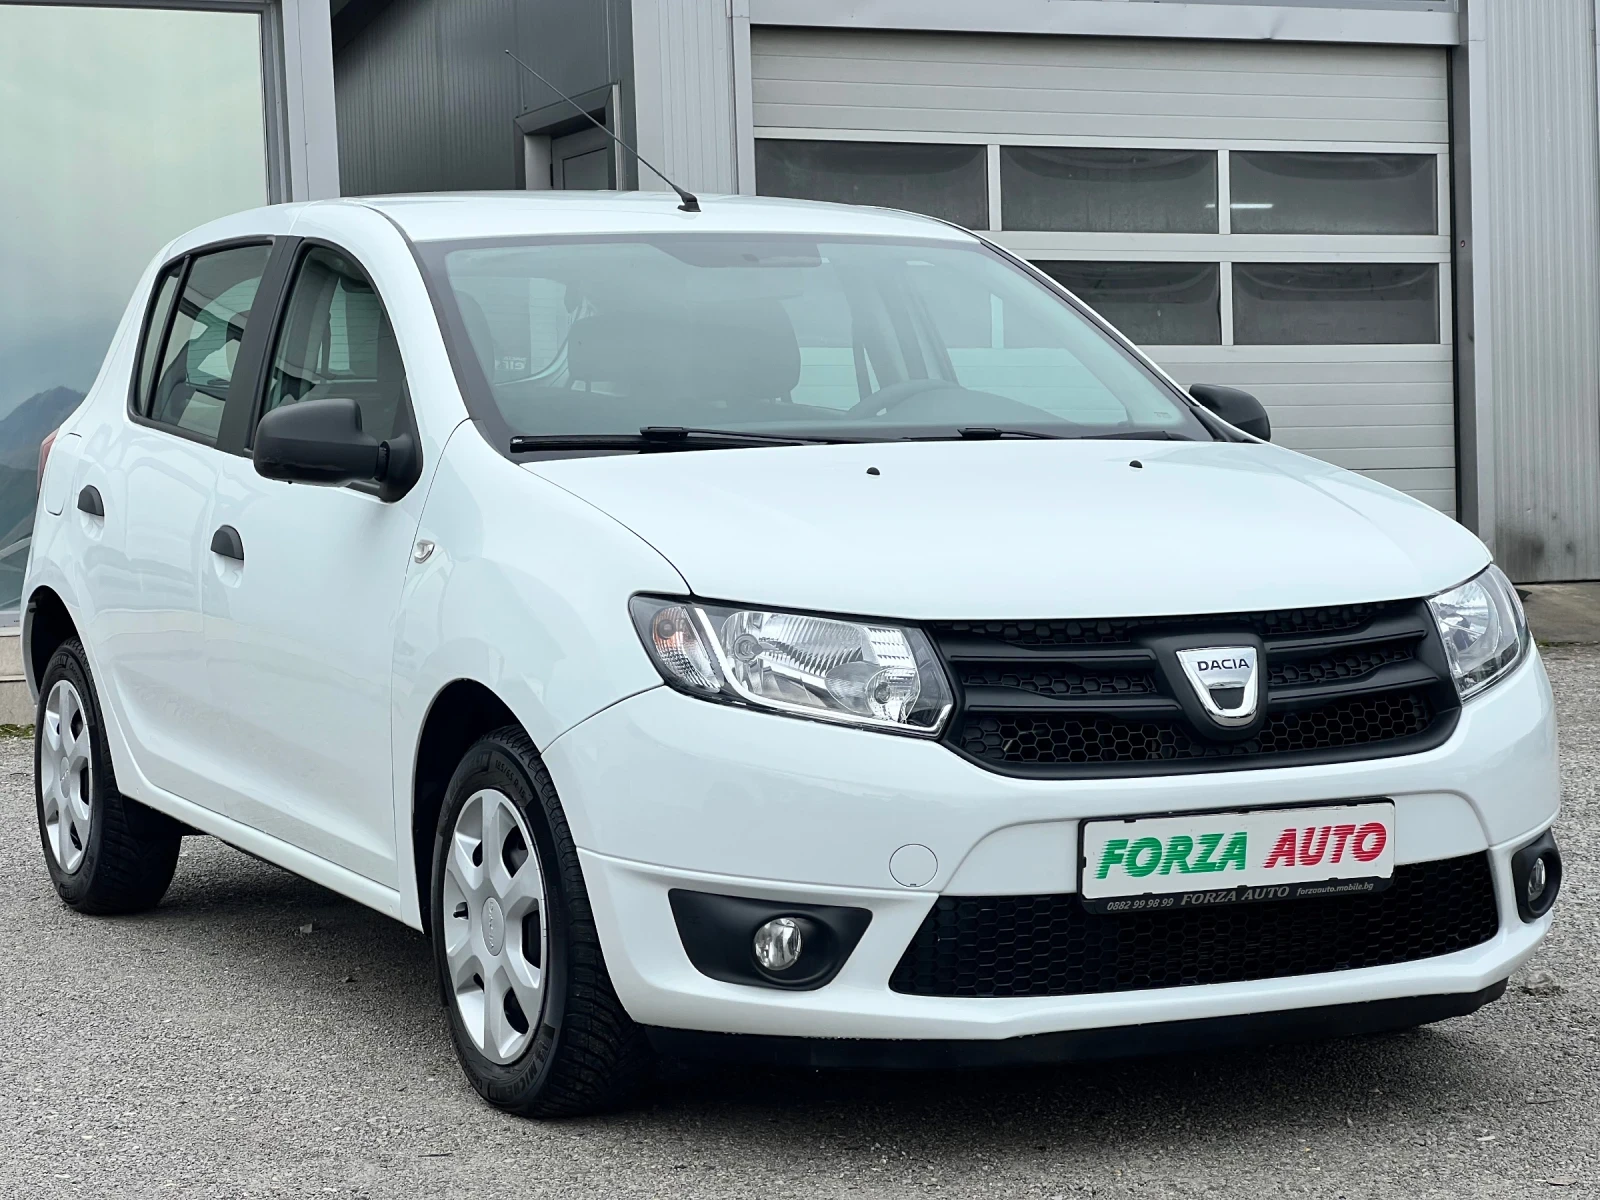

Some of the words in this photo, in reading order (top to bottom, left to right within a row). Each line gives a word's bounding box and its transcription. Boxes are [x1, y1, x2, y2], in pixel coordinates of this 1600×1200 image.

[1197, 658, 1250, 671] DACIA
[1094, 832, 1247, 879] FORZA
[1261, 822, 1387, 868] AUTO
[1180, 891, 1237, 905] FORZA
[1241, 886, 1289, 900] AUTO
[1296, 882, 1374, 896] forzaauto.mobile.bg
[1107, 901, 1131, 911] 0882
[1132, 900, 1145, 909] 99
[1146, 899, 1160, 908] 98
[1160, 898, 1174, 907] 99
